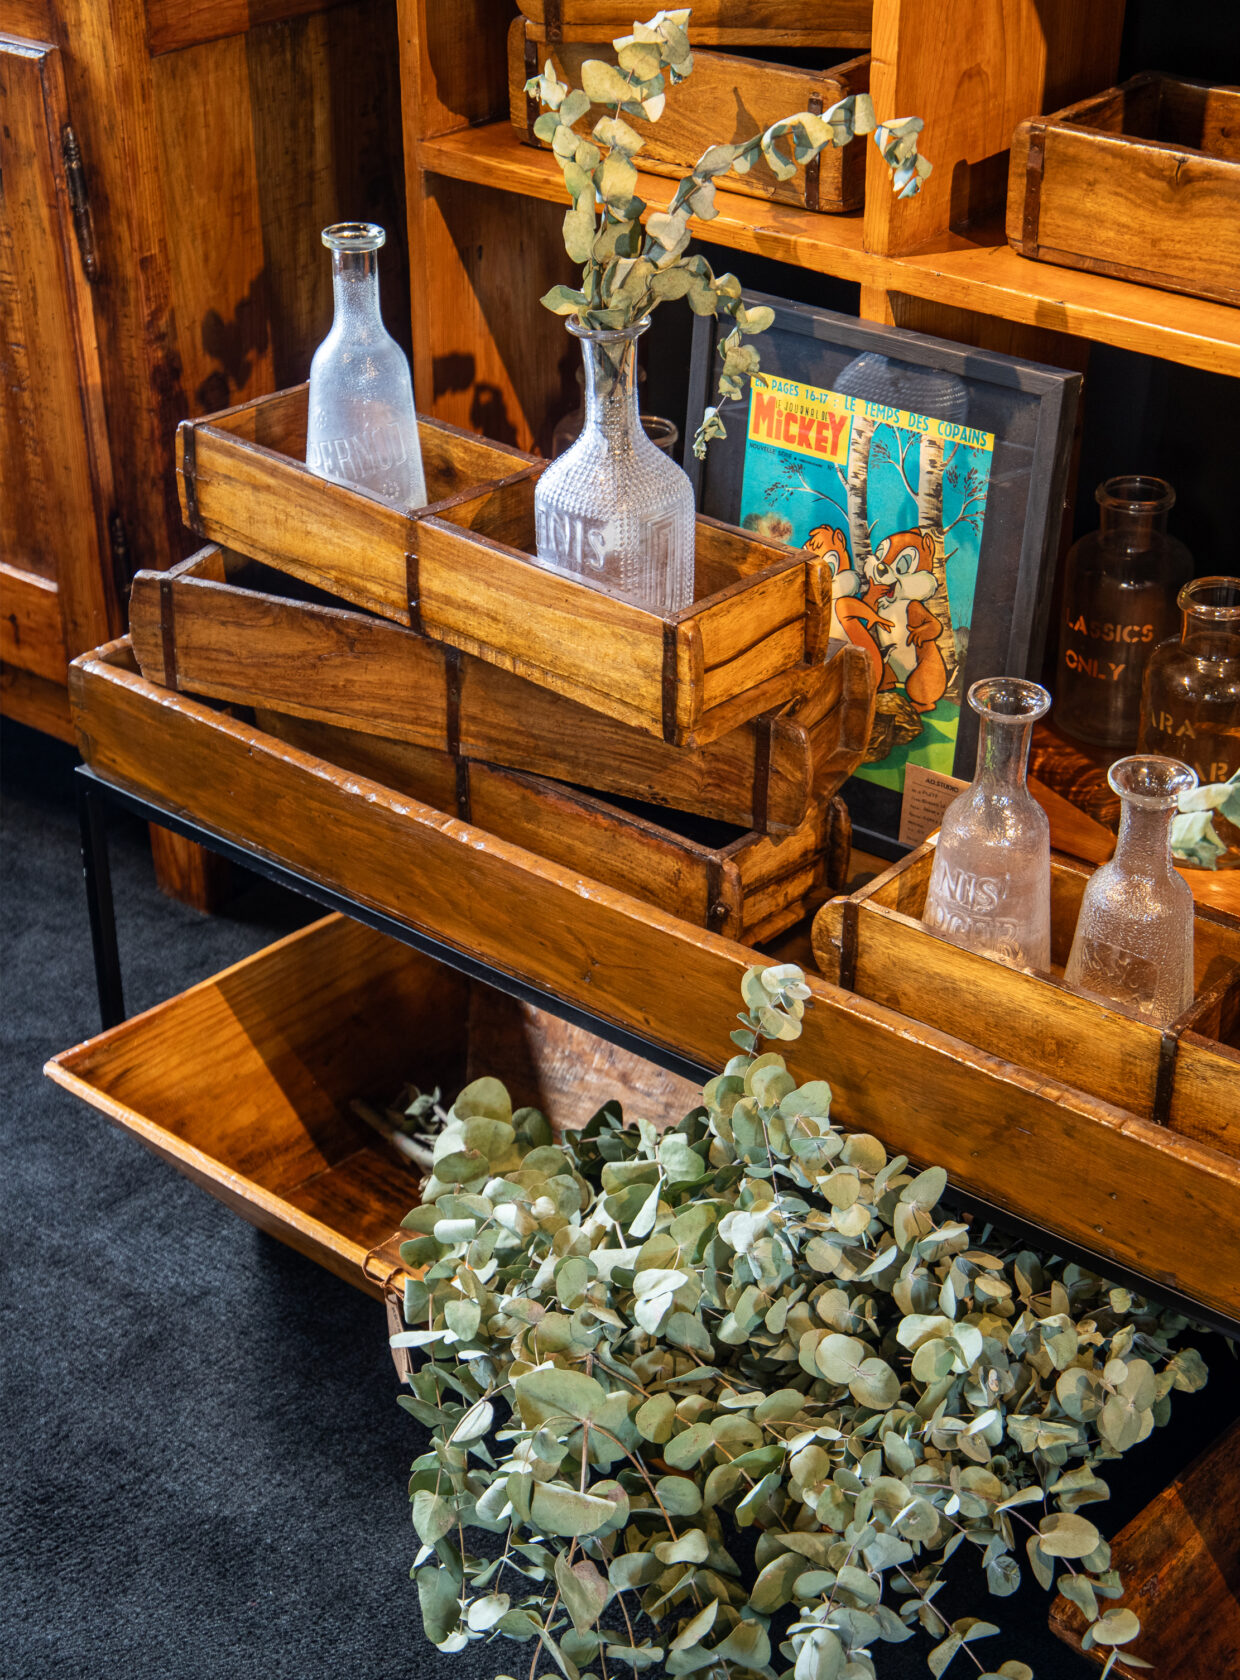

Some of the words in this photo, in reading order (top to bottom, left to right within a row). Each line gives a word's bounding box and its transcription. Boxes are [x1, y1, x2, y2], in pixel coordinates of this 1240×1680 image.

[771, 379, 799, 397] PAGES
[805, 389, 828, 404] 16-17
[845, 395, 856, 412] LE
[864, 400, 900, 424] TEMPS
[908, 412, 930, 432] DES
[937, 420, 988, 448] COPAINS
[784, 401, 819, 420] JOURNAL
[1065, 649, 1126, 681] ONLY
